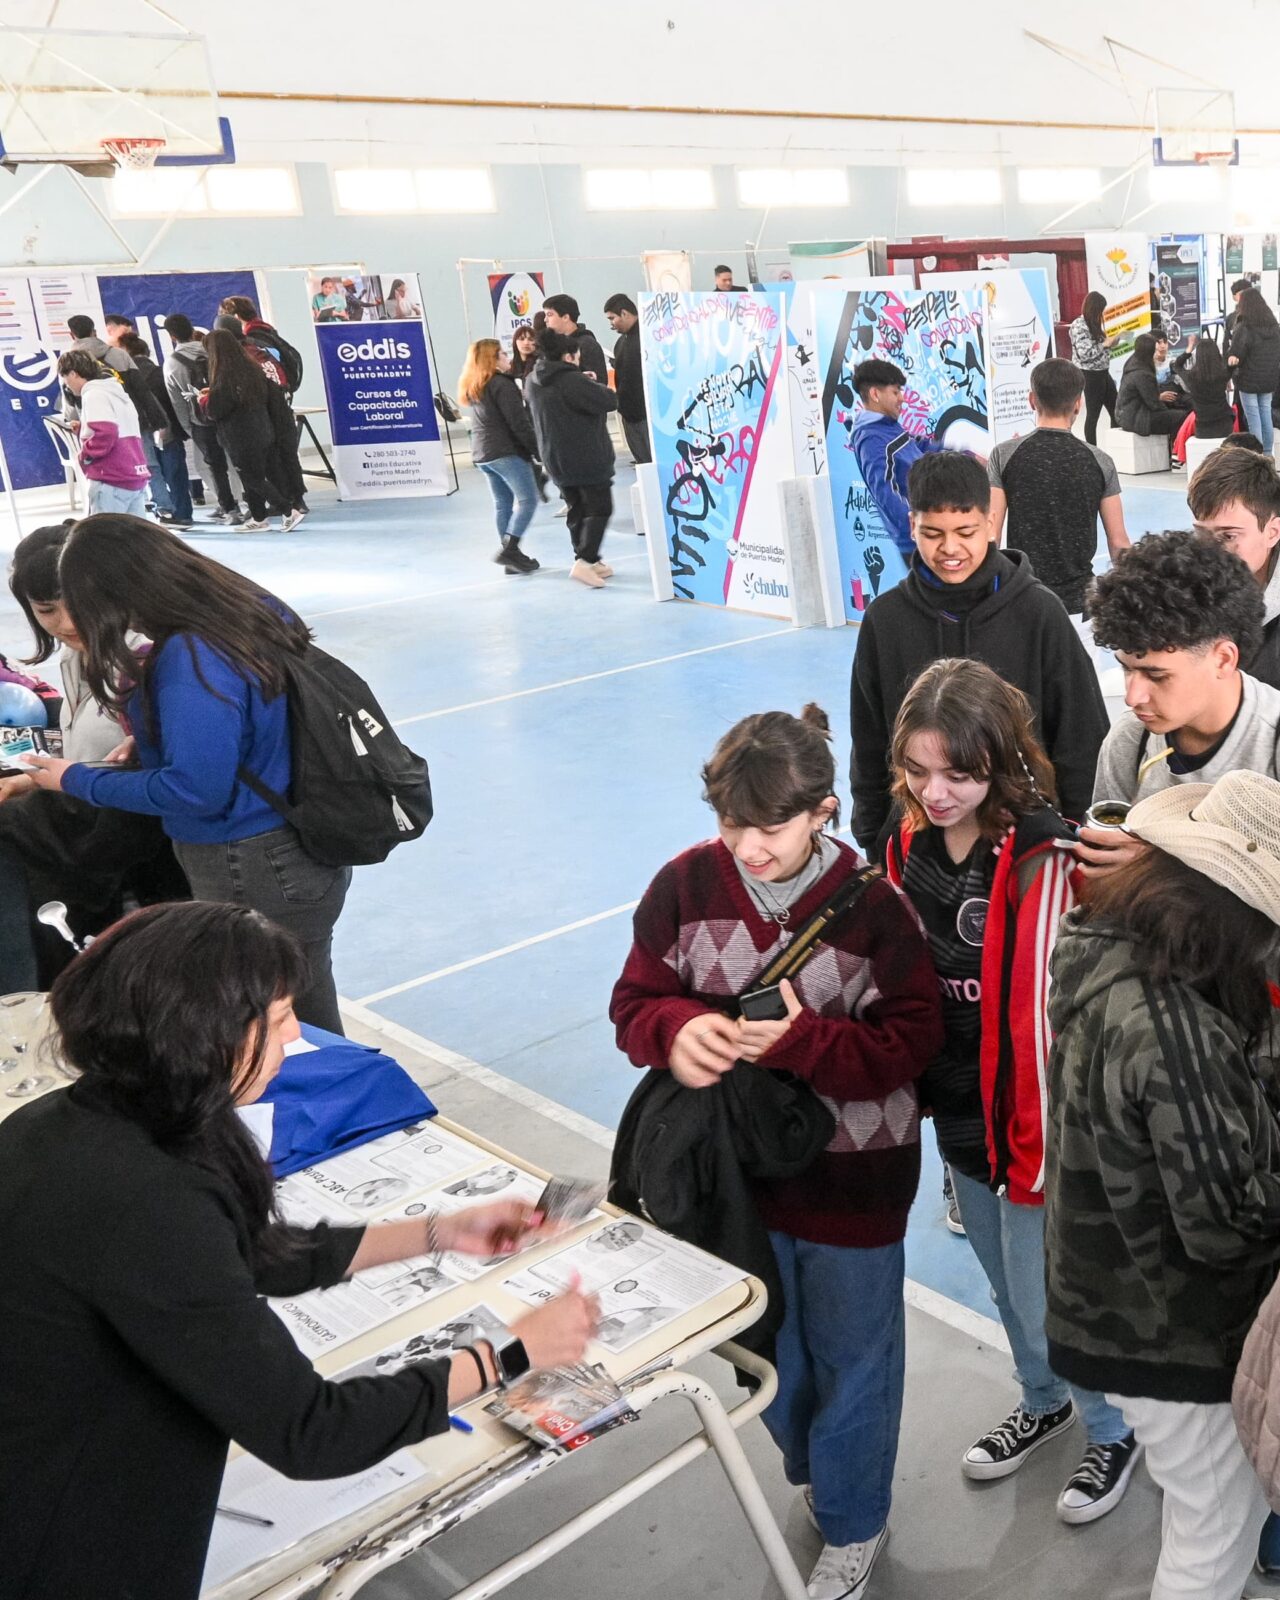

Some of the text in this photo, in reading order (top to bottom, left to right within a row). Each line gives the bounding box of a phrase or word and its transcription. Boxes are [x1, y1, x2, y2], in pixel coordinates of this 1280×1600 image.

[511, 319, 533, 328] IPCS
[337, 338, 411, 363] eddis
[355, 388, 407, 399] Cursos de
[348, 399, 418, 412] Capacitación
[365, 410, 404, 421] Laboral
